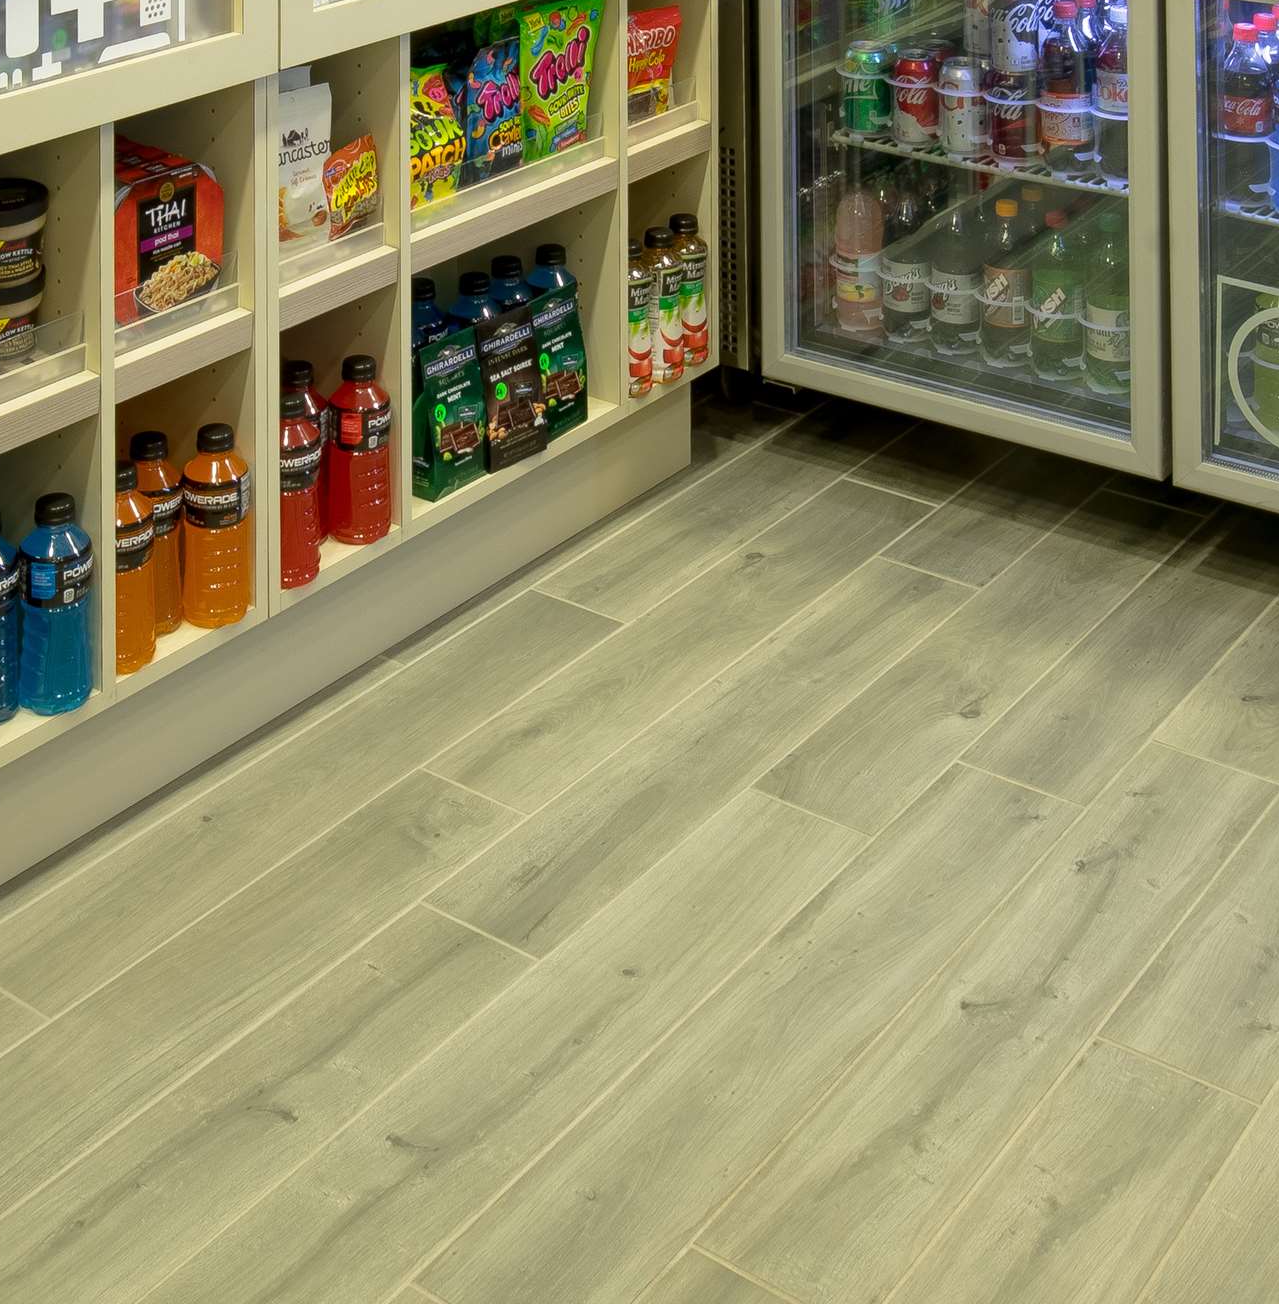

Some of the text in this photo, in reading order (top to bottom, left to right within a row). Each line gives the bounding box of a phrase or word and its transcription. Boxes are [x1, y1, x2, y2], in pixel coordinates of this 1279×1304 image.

[410, 139, 467, 180] PATCH
[145, 198, 187, 227] THAI
[533, 301, 574, 327] GHIRARDELLI
[483, 328, 531, 352] GHIRARDELLI
[426, 348, 474, 376] GHIRARDELLI
